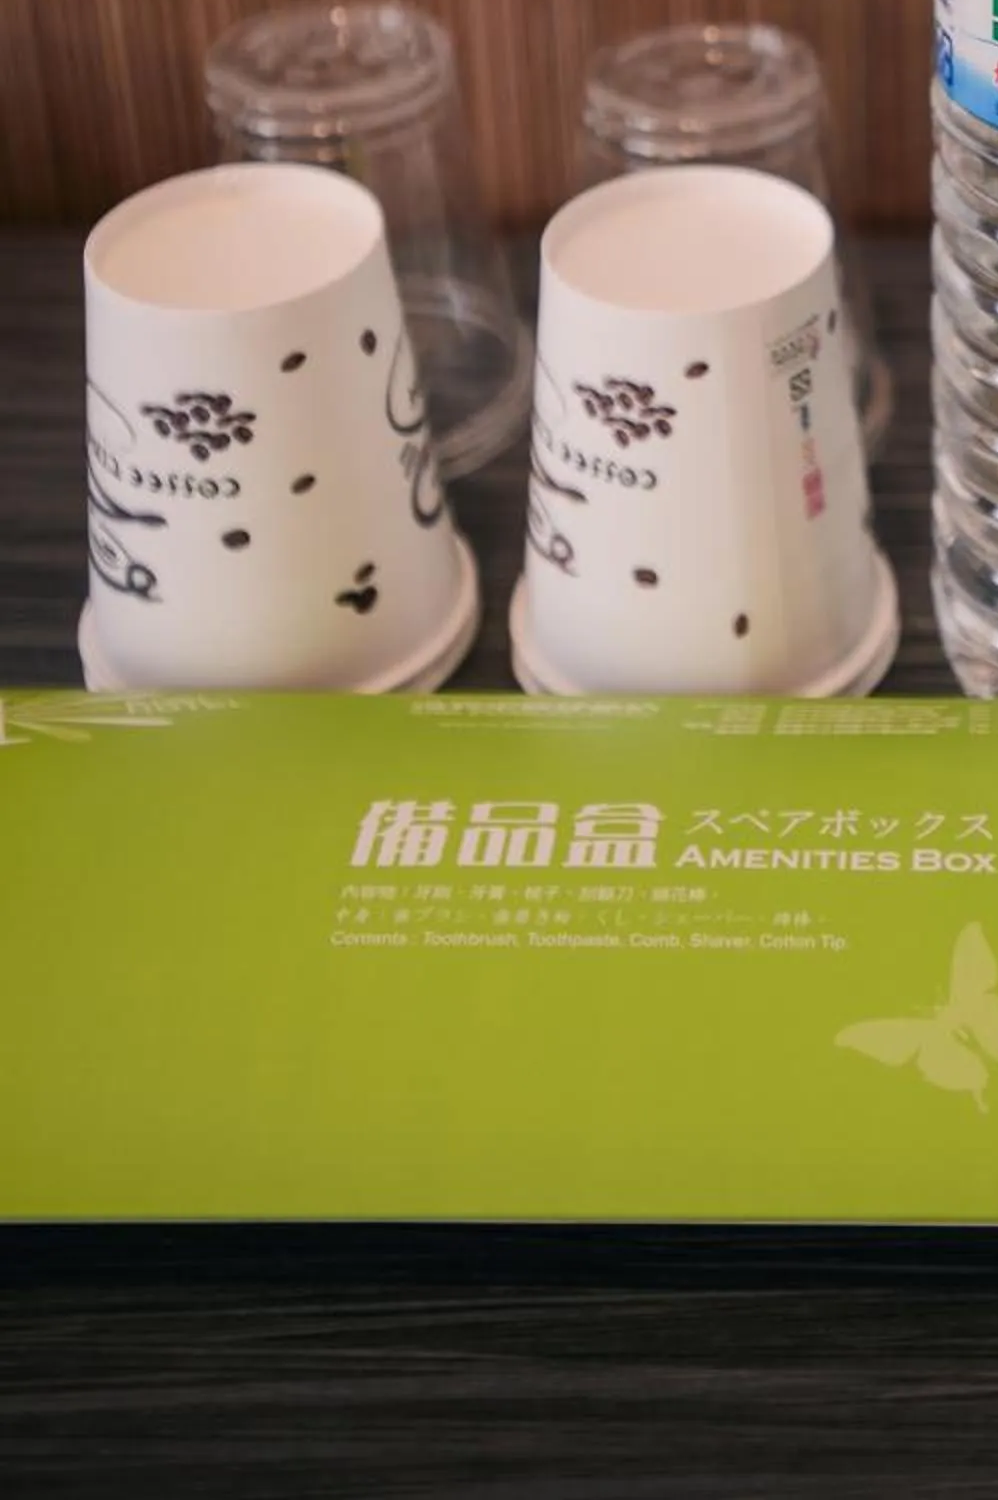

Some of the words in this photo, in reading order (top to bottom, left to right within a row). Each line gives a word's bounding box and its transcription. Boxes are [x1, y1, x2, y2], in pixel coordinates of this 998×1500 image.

[351, 798, 666, 869] 備品盒
[686, 806, 995, 842] スペアボックス
